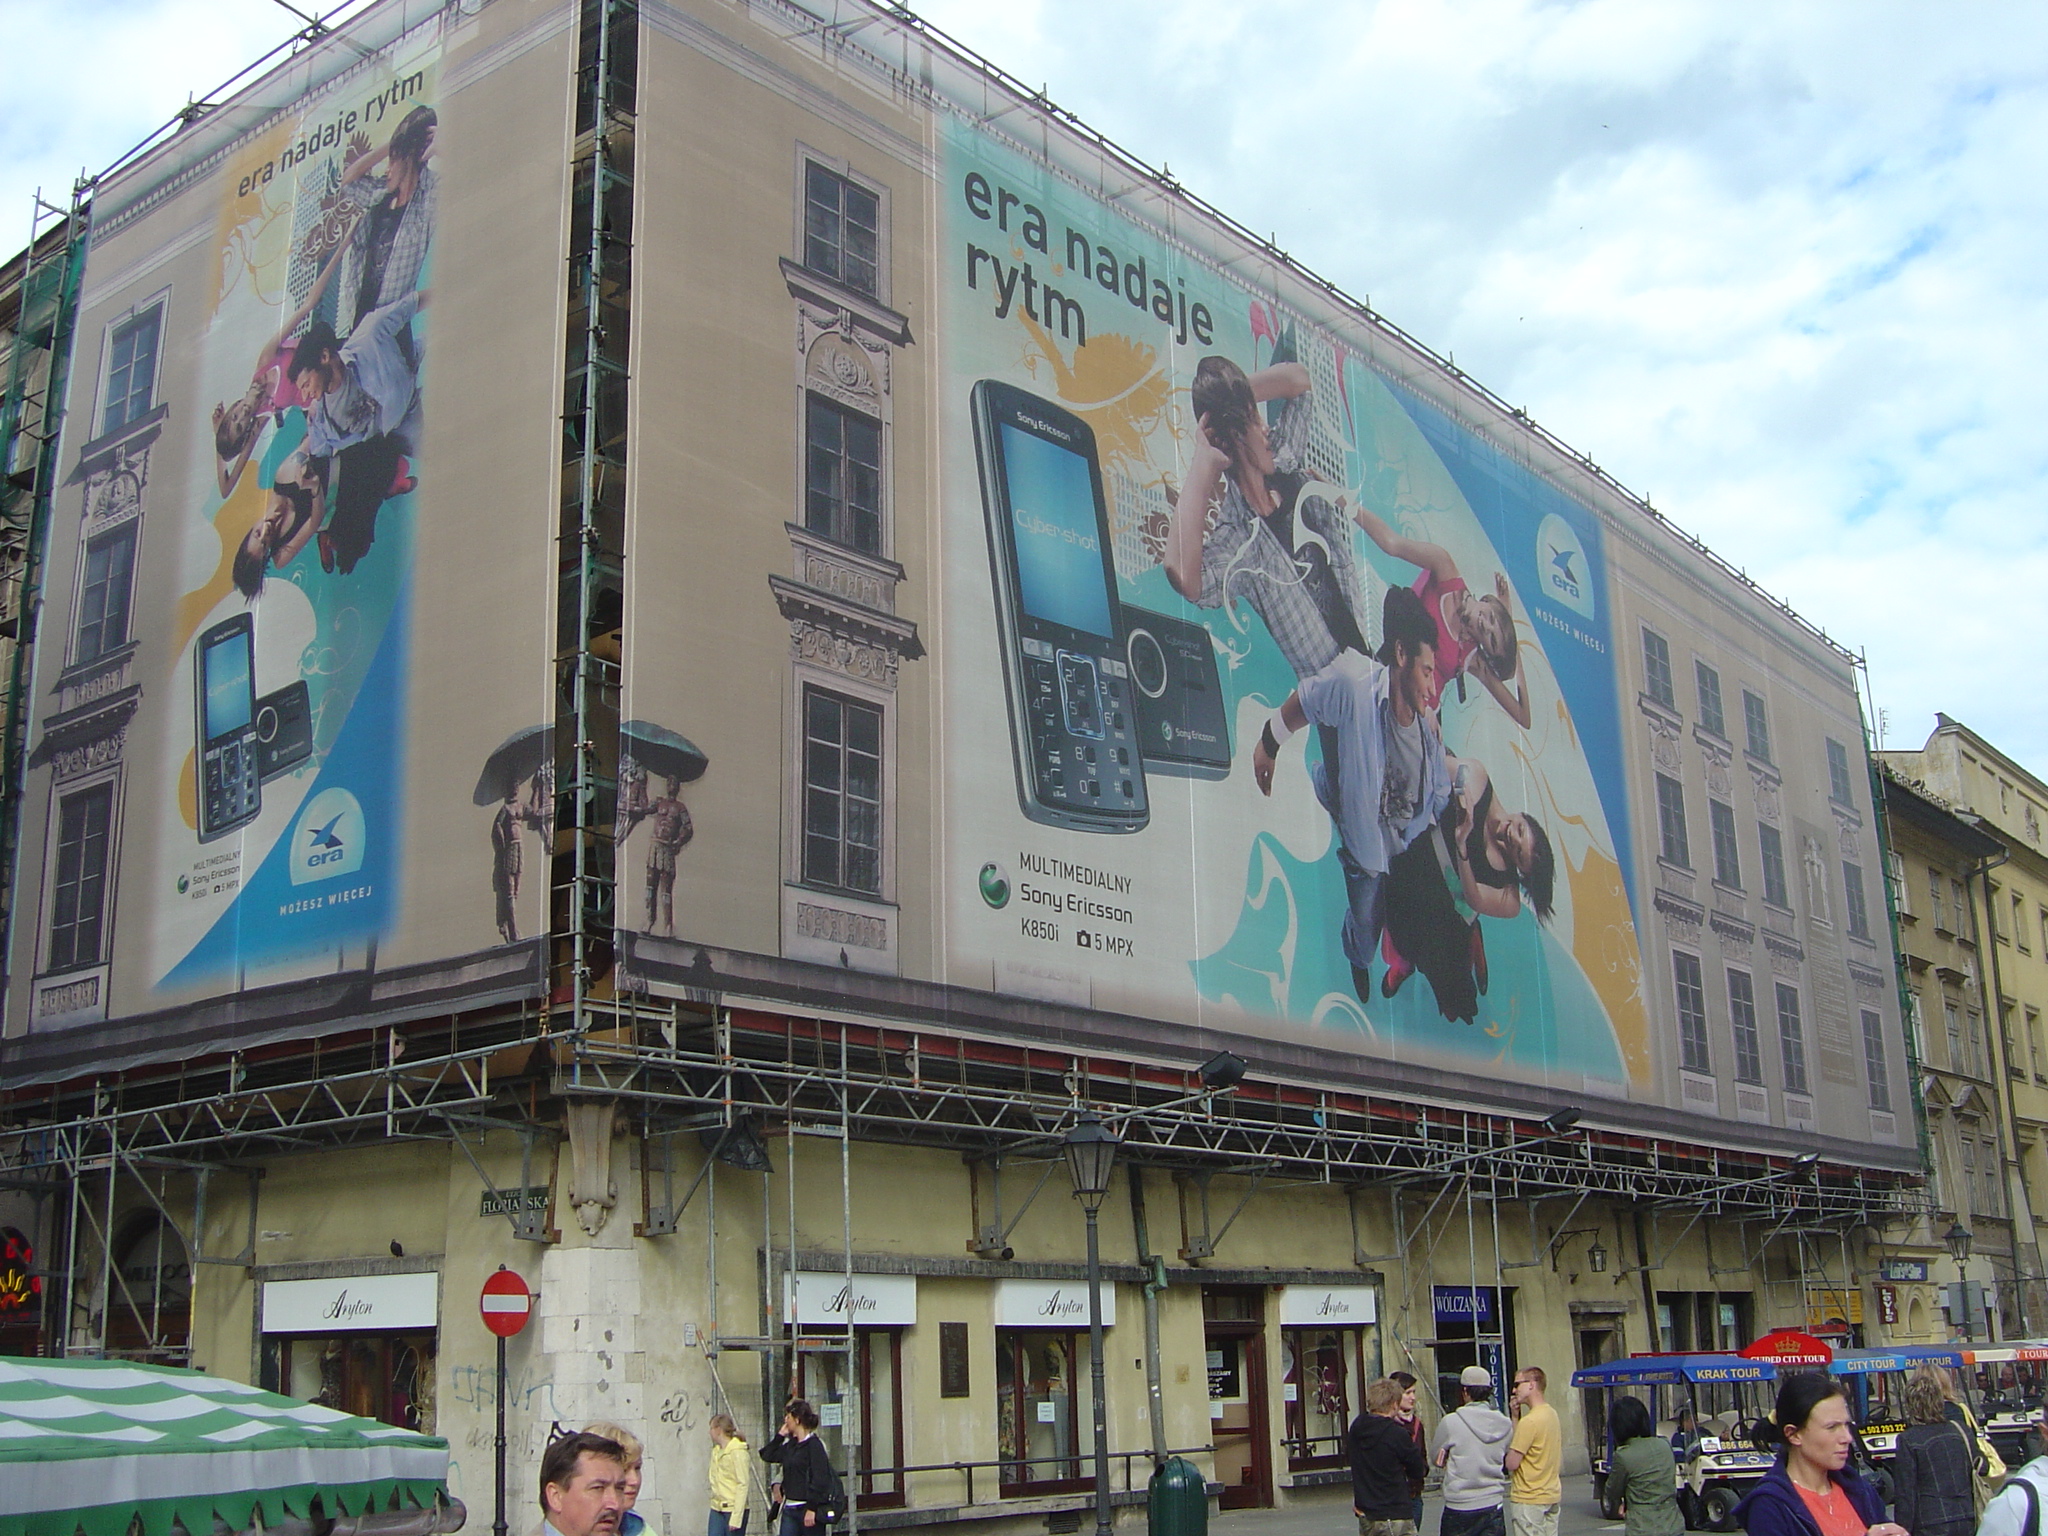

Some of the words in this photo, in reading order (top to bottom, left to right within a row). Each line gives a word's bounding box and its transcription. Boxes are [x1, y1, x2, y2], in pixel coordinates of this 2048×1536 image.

[238, 161, 274, 197] era
[280, 110, 357, 173] nadaje
[364, 71, 423, 122] rytm
[964, 171, 1048, 255] era
[1066, 226, 1213, 346] nadaje
[967, 242, 1086, 348] rytm
[1016, 411, 1038, 430] Sony
[1039, 420, 1071, 442] Ericsson
[1015, 508, 1097, 552] Cyber-shot
[1552, 573, 1580, 599] era
[307, 849, 343, 867] era
[1020, 852, 1132, 894] MULTIMEDIALNY
[280, 897, 323, 916] MOŻESZ
[328, 885, 372, 905] WIĘCEJ
[1021, 883, 1062, 913] Sony
[1067, 893, 1133, 924] Ericsson
[1021, 917, 1059, 942] K850i
[1095, 933, 1102, 951] 5
[1106, 935, 1134, 957] MPX
[483, 1196, 549, 1213] FLOIASKA
[323, 1289, 373, 1320] Aryton
[1038, 1289, 1083, 1318] Aryton
[1315, 1293, 1349, 1317] Aryton
[1435, 1291, 1487, 1313] WÓLCZANKA
[1782, 1355, 1802, 1363] CITY
[1802, 1354, 1826, 1363] TOUR
[1847, 1360, 1868, 1371] CITY
[1869, 1359, 1896, 1369] TOUR
[1905, 1357, 1924, 1367] RAK
[1926, 1356, 1952, 1366] TOUR
[2024, 1350, 2048, 1359] TOUR
[1697, 1369, 1727, 1380] KRAK
[1730, 1367, 1761, 1378] TOUR
